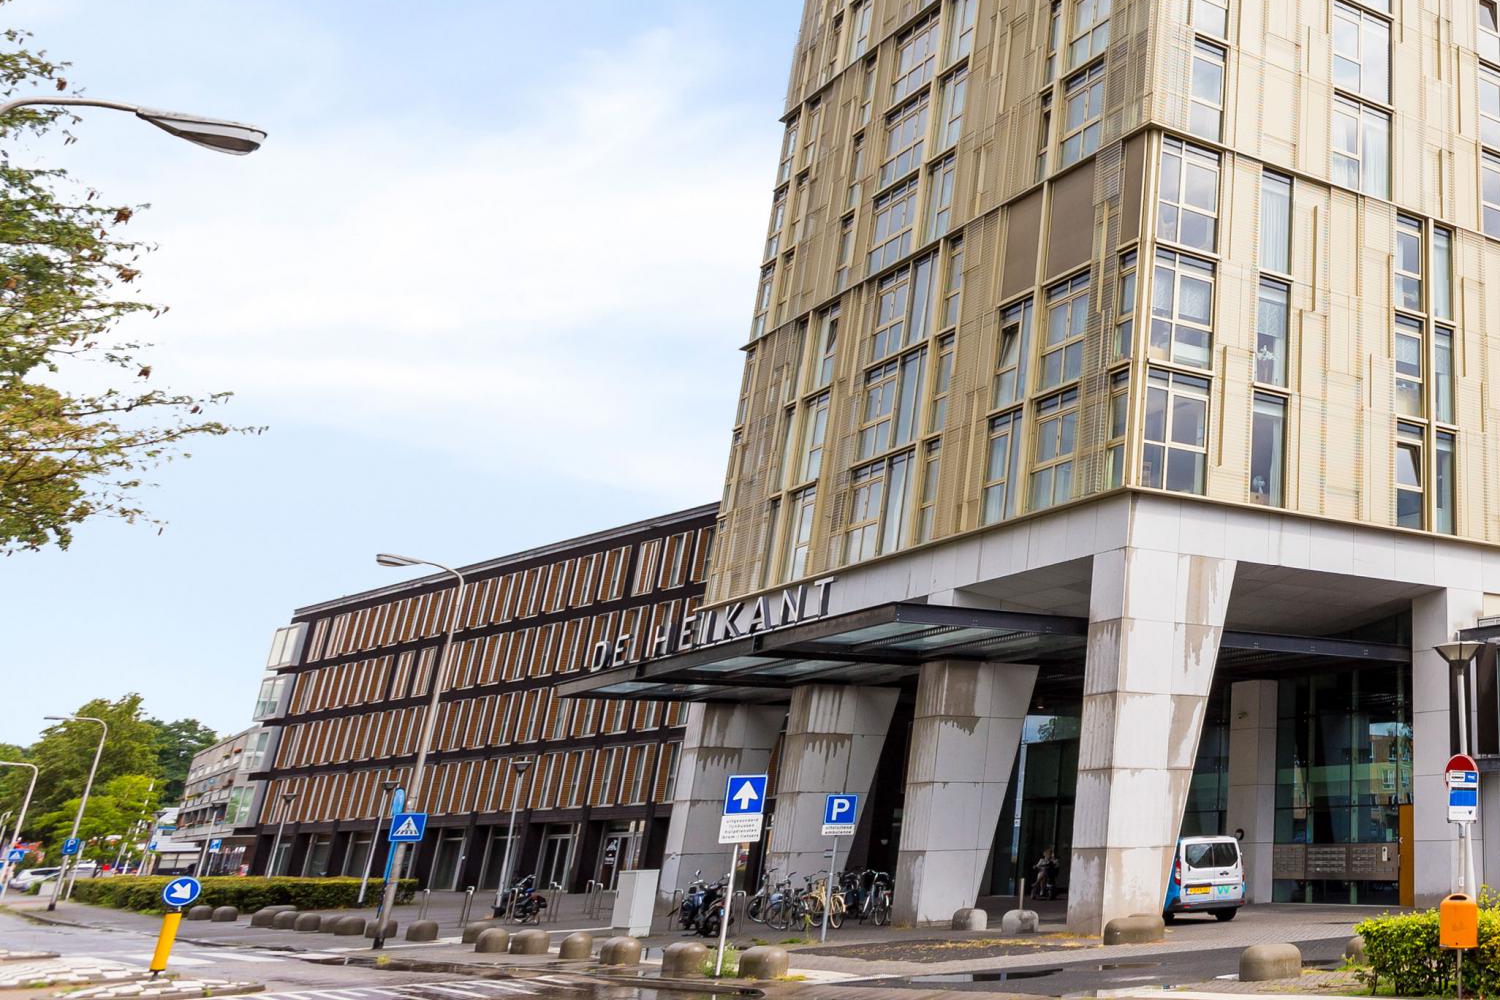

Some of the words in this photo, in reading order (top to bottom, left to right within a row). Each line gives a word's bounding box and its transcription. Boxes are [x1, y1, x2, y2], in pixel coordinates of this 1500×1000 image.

[590, 632, 632, 673] DE
[651, 576, 838, 658] HEIKANT
[831, 798, 850, 821] P
